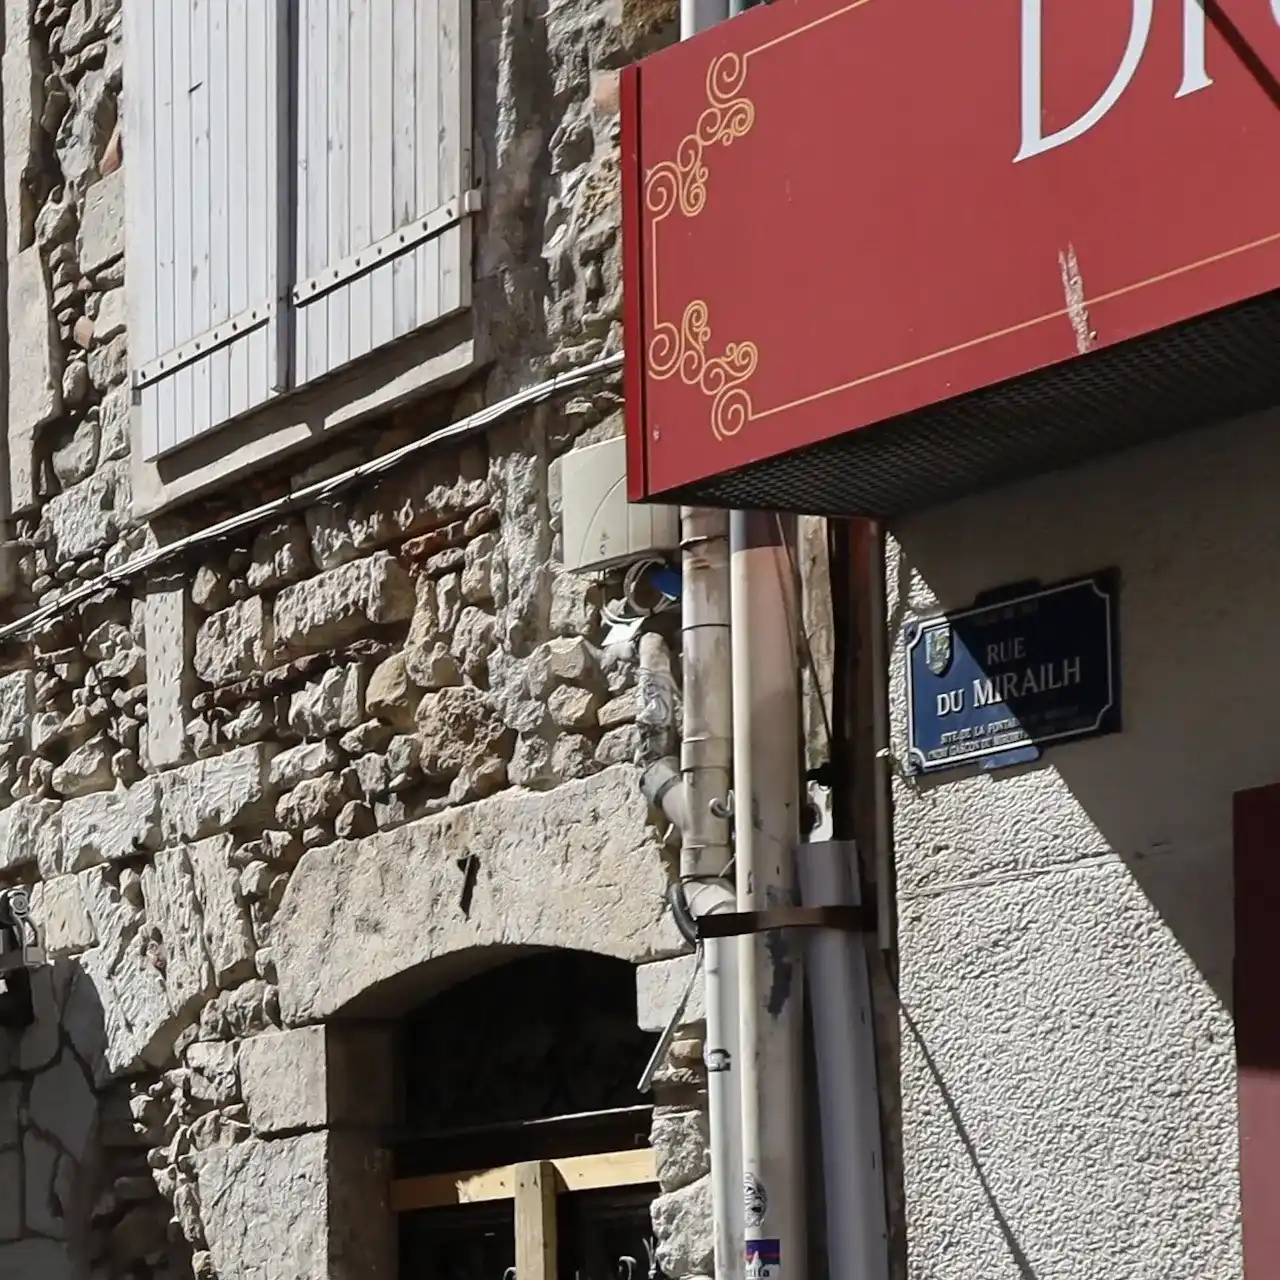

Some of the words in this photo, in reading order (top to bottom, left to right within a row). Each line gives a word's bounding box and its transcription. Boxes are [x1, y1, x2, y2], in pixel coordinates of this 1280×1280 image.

[987, 637, 1027, 665] RUE
[936, 688, 965, 716] DU
[973, 656, 1081, 708] MIRAILH
